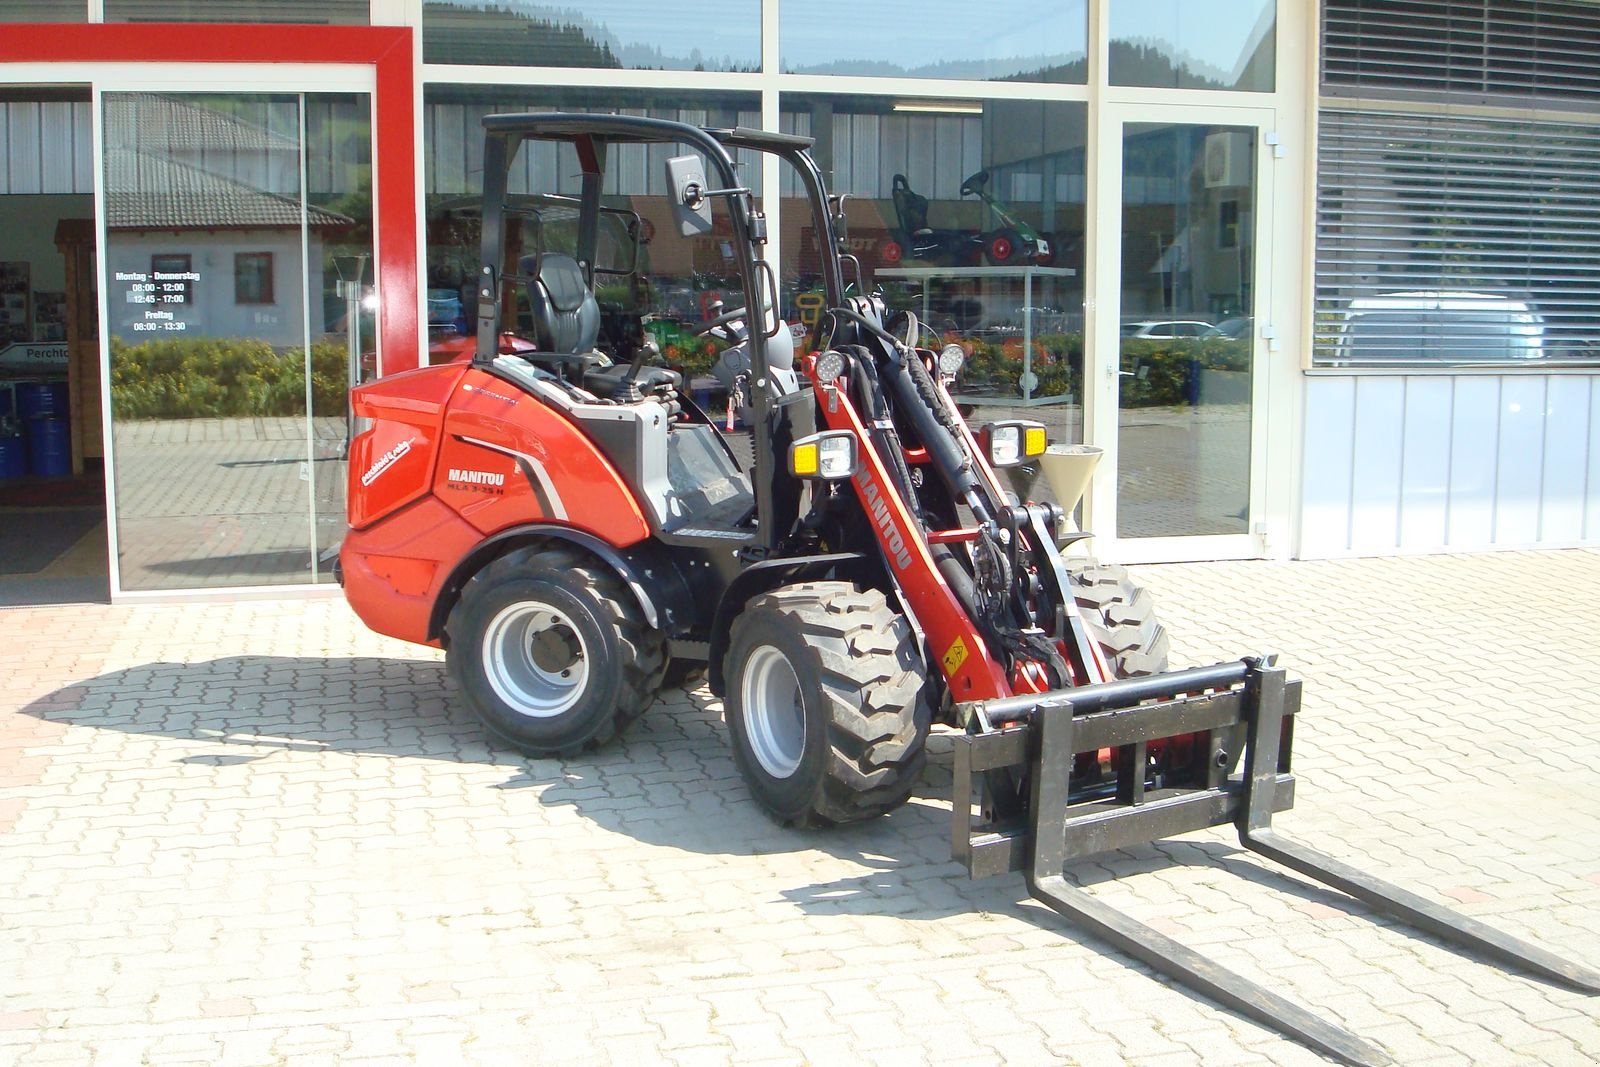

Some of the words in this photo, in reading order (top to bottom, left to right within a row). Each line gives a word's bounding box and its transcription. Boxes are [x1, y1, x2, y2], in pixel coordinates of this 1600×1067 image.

[115, 272, 147, 281] Montag
[154, 272, 200, 281] Donnerstag
[132, 283, 155, 291] 08:00
[162, 283, 184, 291] 12:00
[133, 295, 155, 303] 12:45
[162, 295, 184, 303] 17:00
[145, 311, 173, 320] Freitag
[133, 323, 156, 331] 08:00
[164, 322, 185, 330] 13:30
[448, 468, 505, 486] MANITOU
[856, 461, 912, 570] MANITOU
